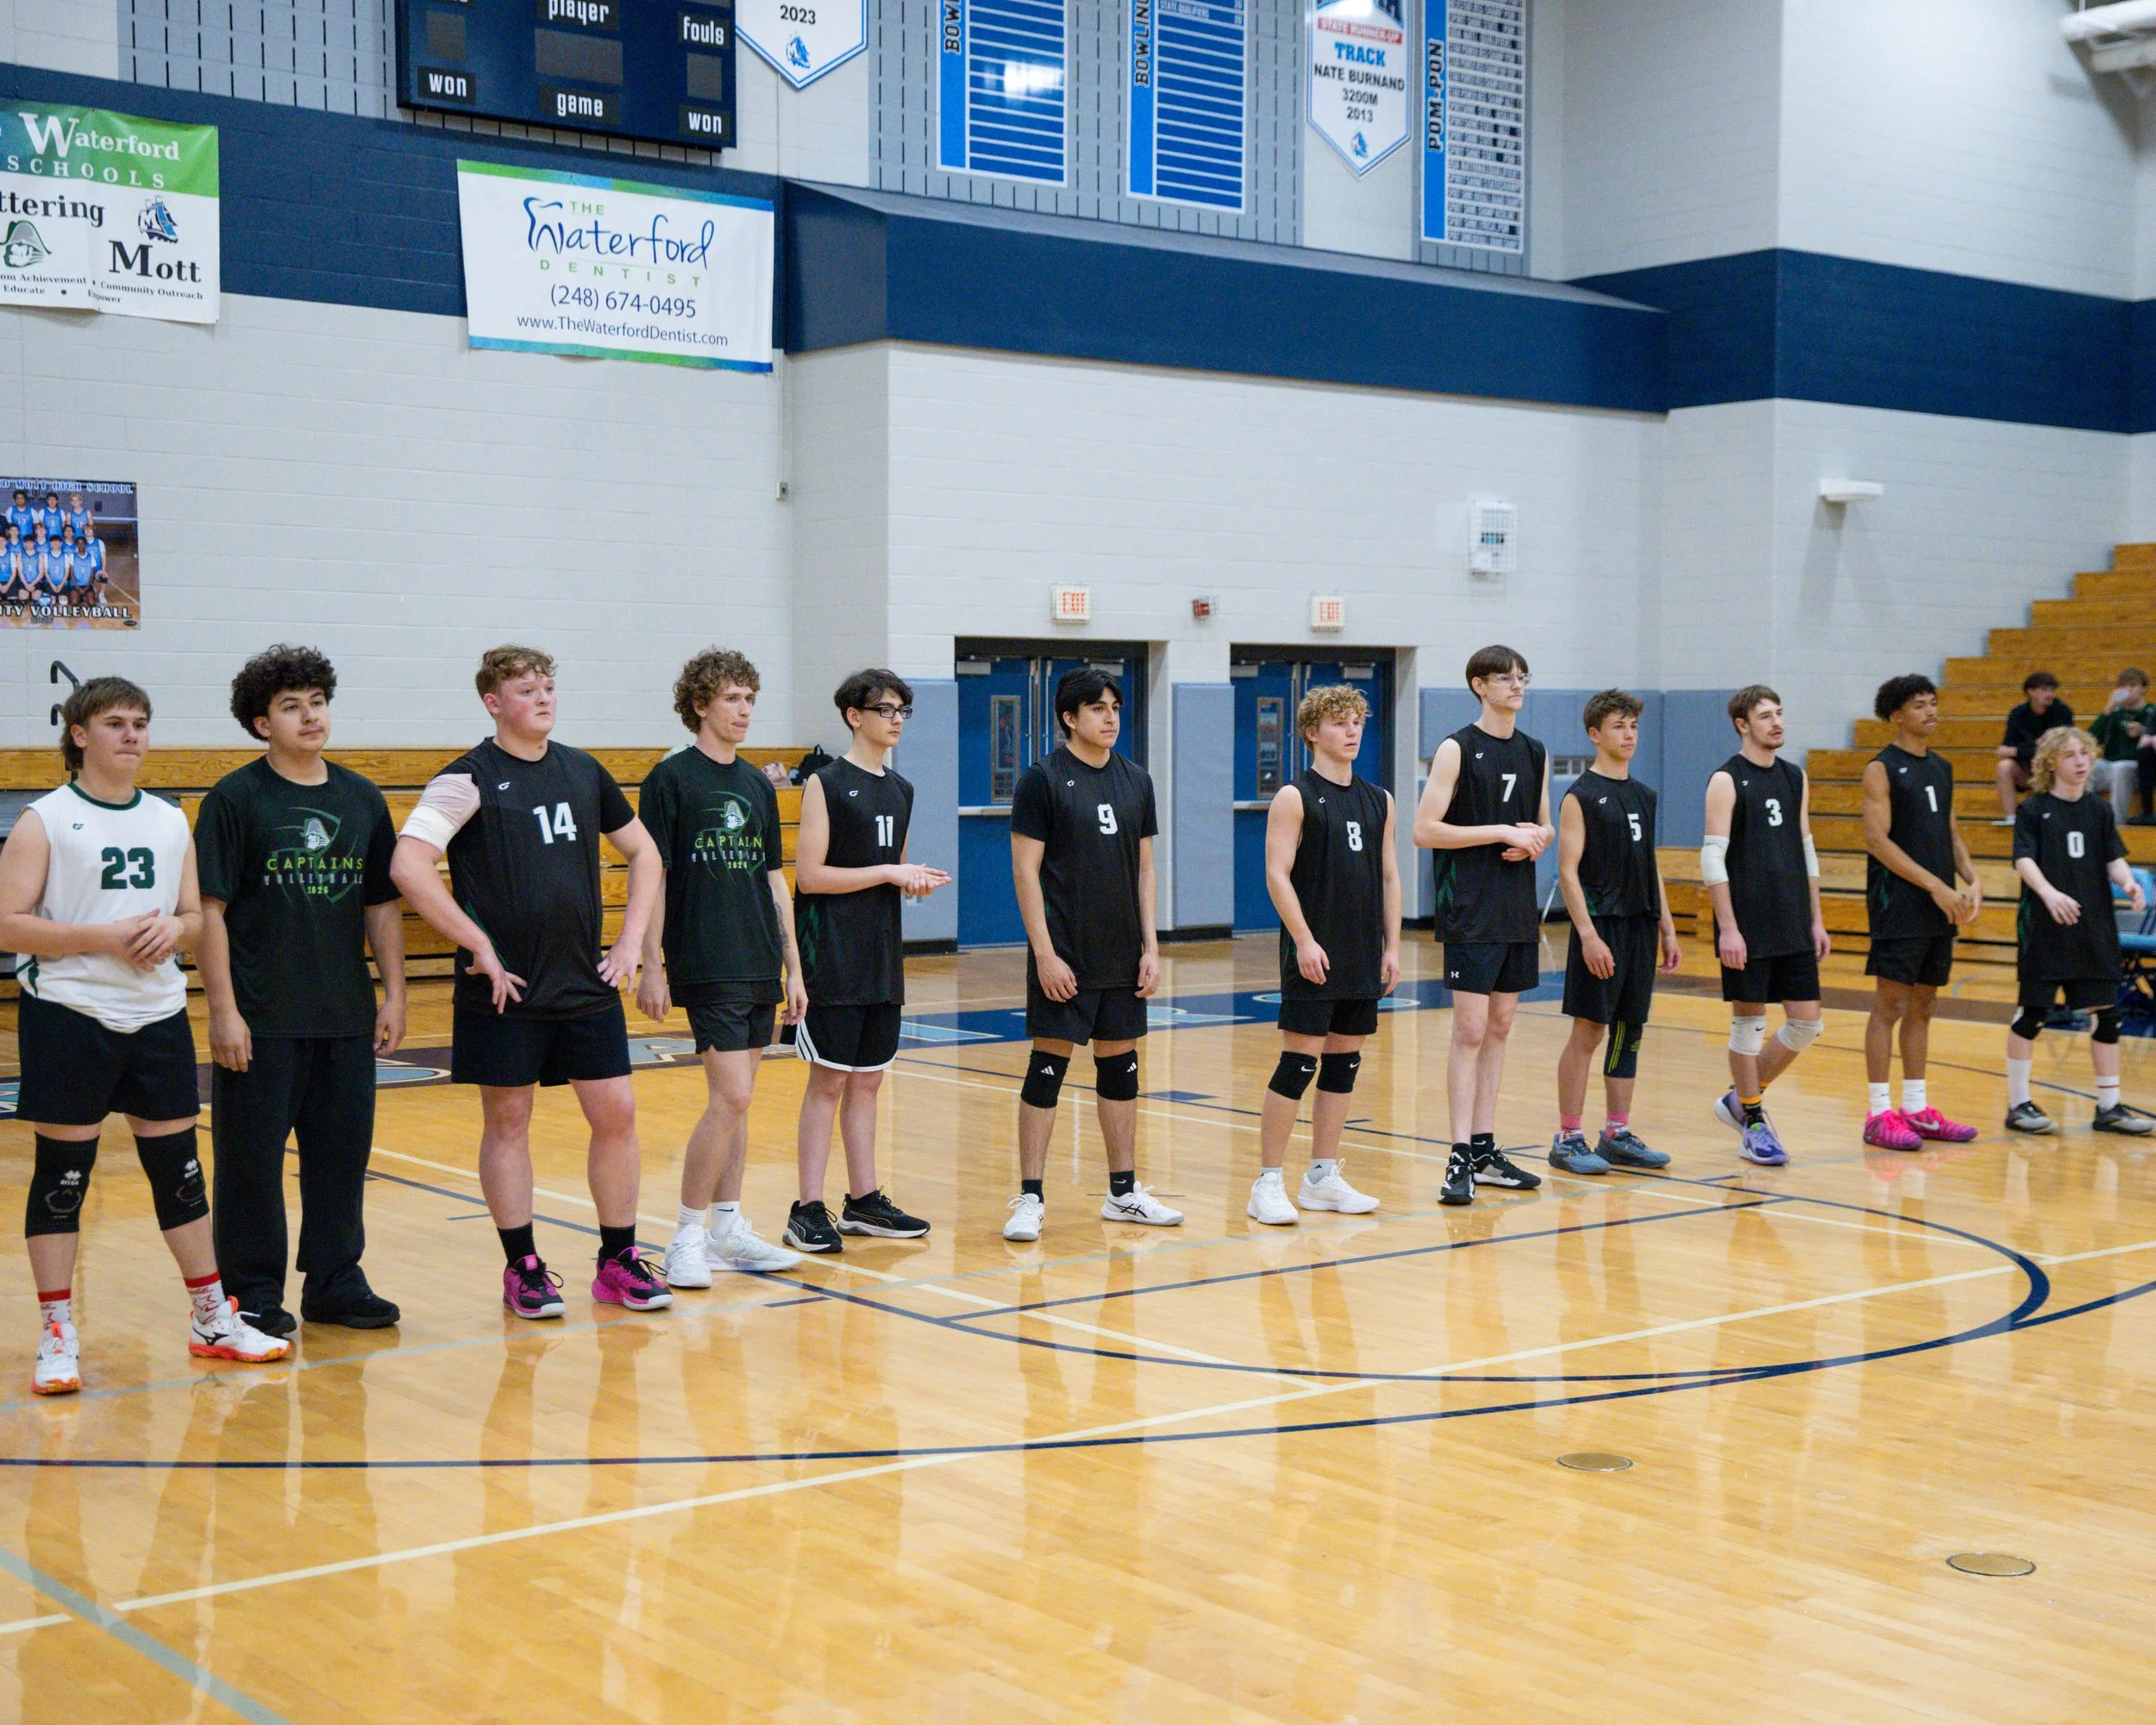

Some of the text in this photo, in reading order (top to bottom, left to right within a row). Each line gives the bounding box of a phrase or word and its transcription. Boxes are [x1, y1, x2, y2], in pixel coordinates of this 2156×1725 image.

[549, 0, 609, 26] player
[780, 5, 816, 25] 2023
[945, 0, 959, 52] BOW
[683, 16, 724, 45] fouls
[1334, 41, 1386, 67] TRACK
[429, 72, 467, 97] won
[1314, 63, 1405, 91] NATE BURNAND
[557, 92, 604, 117] game
[1342, 87, 1378, 105] 3200M
[1428, 42, 1442, 150] POM-PON
[688, 111, 722, 135] won
[1346, 106, 1374, 123] 2013
[18, 111, 180, 161] Waterford
[7, 154, 165, 189] SCHOOLS
[569, 201, 605, 216] THE
[523, 197, 715, 270] Waterford
[109, 240, 202, 283] Mott
[540, 259, 700, 288] DENTIST
[3, 284, 46, 295] Educate
[20, 273, 87, 285] Achievement
[100, 280, 154, 295] Community
[158, 287, 204, 300] Outreach
[550, 284, 696, 318] (248) 674-0495
[517, 315, 728, 347] www.TheWaterfordDentist.com
[52, 480, 82, 492] HIGH
[86, 482, 134, 494] SCHOOL
[30, 605, 132, 618] VOLLEYBALL
[1501, 773, 1518, 802] 7
[1925, 785, 1939, 812] 1
[532, 801, 577, 844] 14
[1097, 803, 1119, 835] 9
[1627, 812, 1642, 842] 5
[1765, 798, 1783, 827] 3
[875, 814, 893, 848] 11
[1346, 820, 1364, 852] 8
[2066, 831, 2086, 858] 0
[100, 846, 155, 890] 23
[266, 856, 363, 871] CAPTAINS
